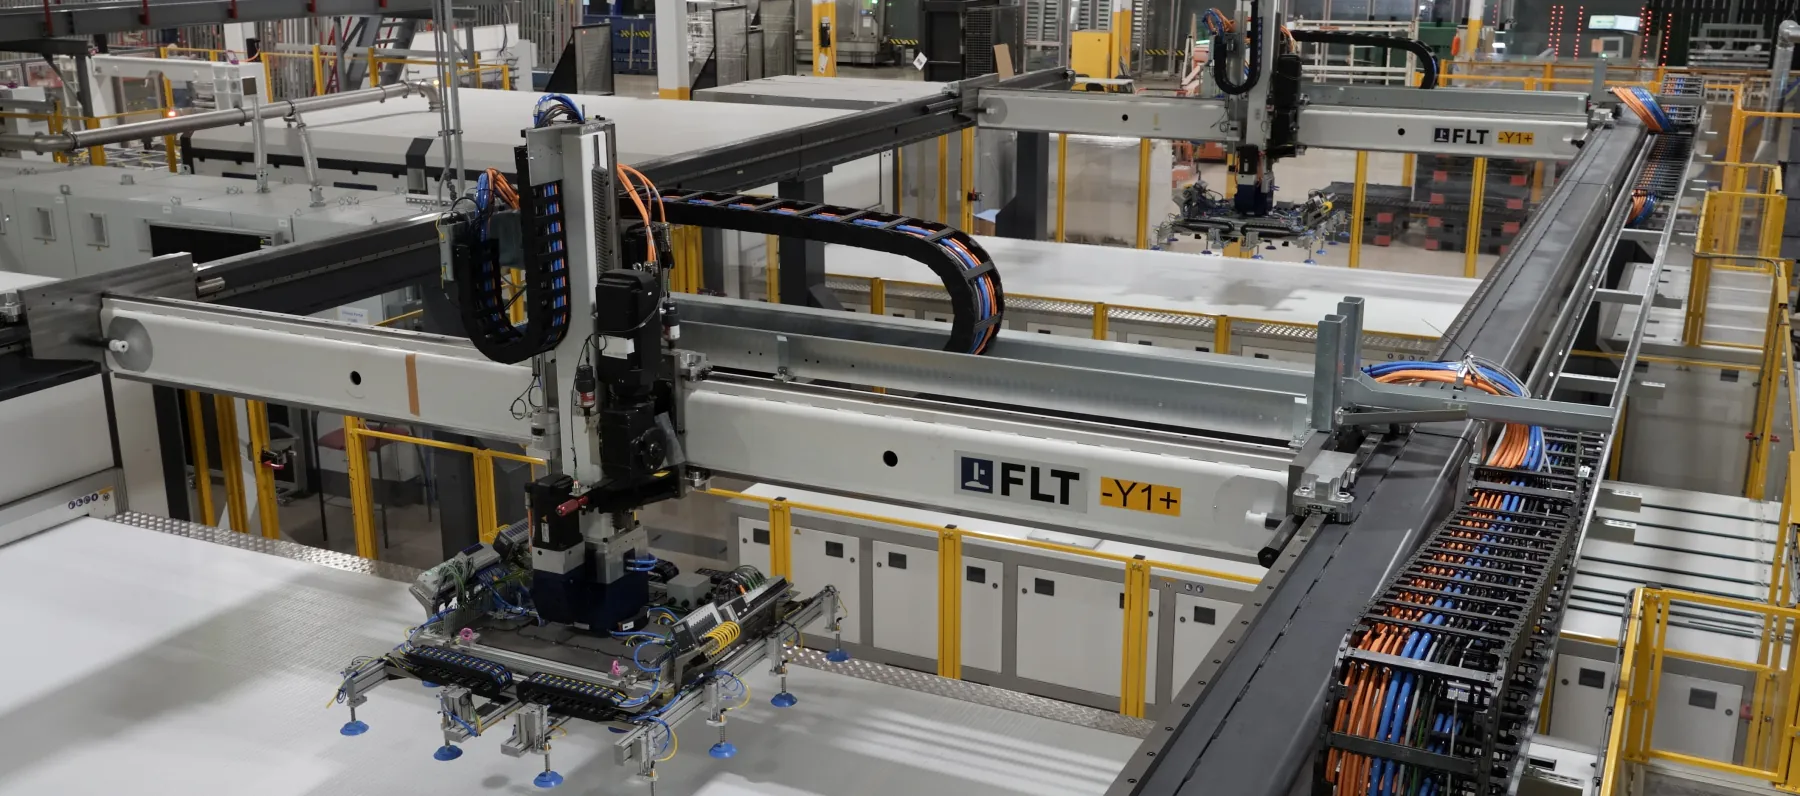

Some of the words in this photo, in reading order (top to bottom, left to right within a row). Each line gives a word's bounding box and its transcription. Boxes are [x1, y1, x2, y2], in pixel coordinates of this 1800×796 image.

[1452, 128, 1489, 144] FLT
[1498, 132, 1532, 144] -Y1+
[1001, 462, 1080, 505] FLT
[1102, 479, 1178, 510] -Y1+
